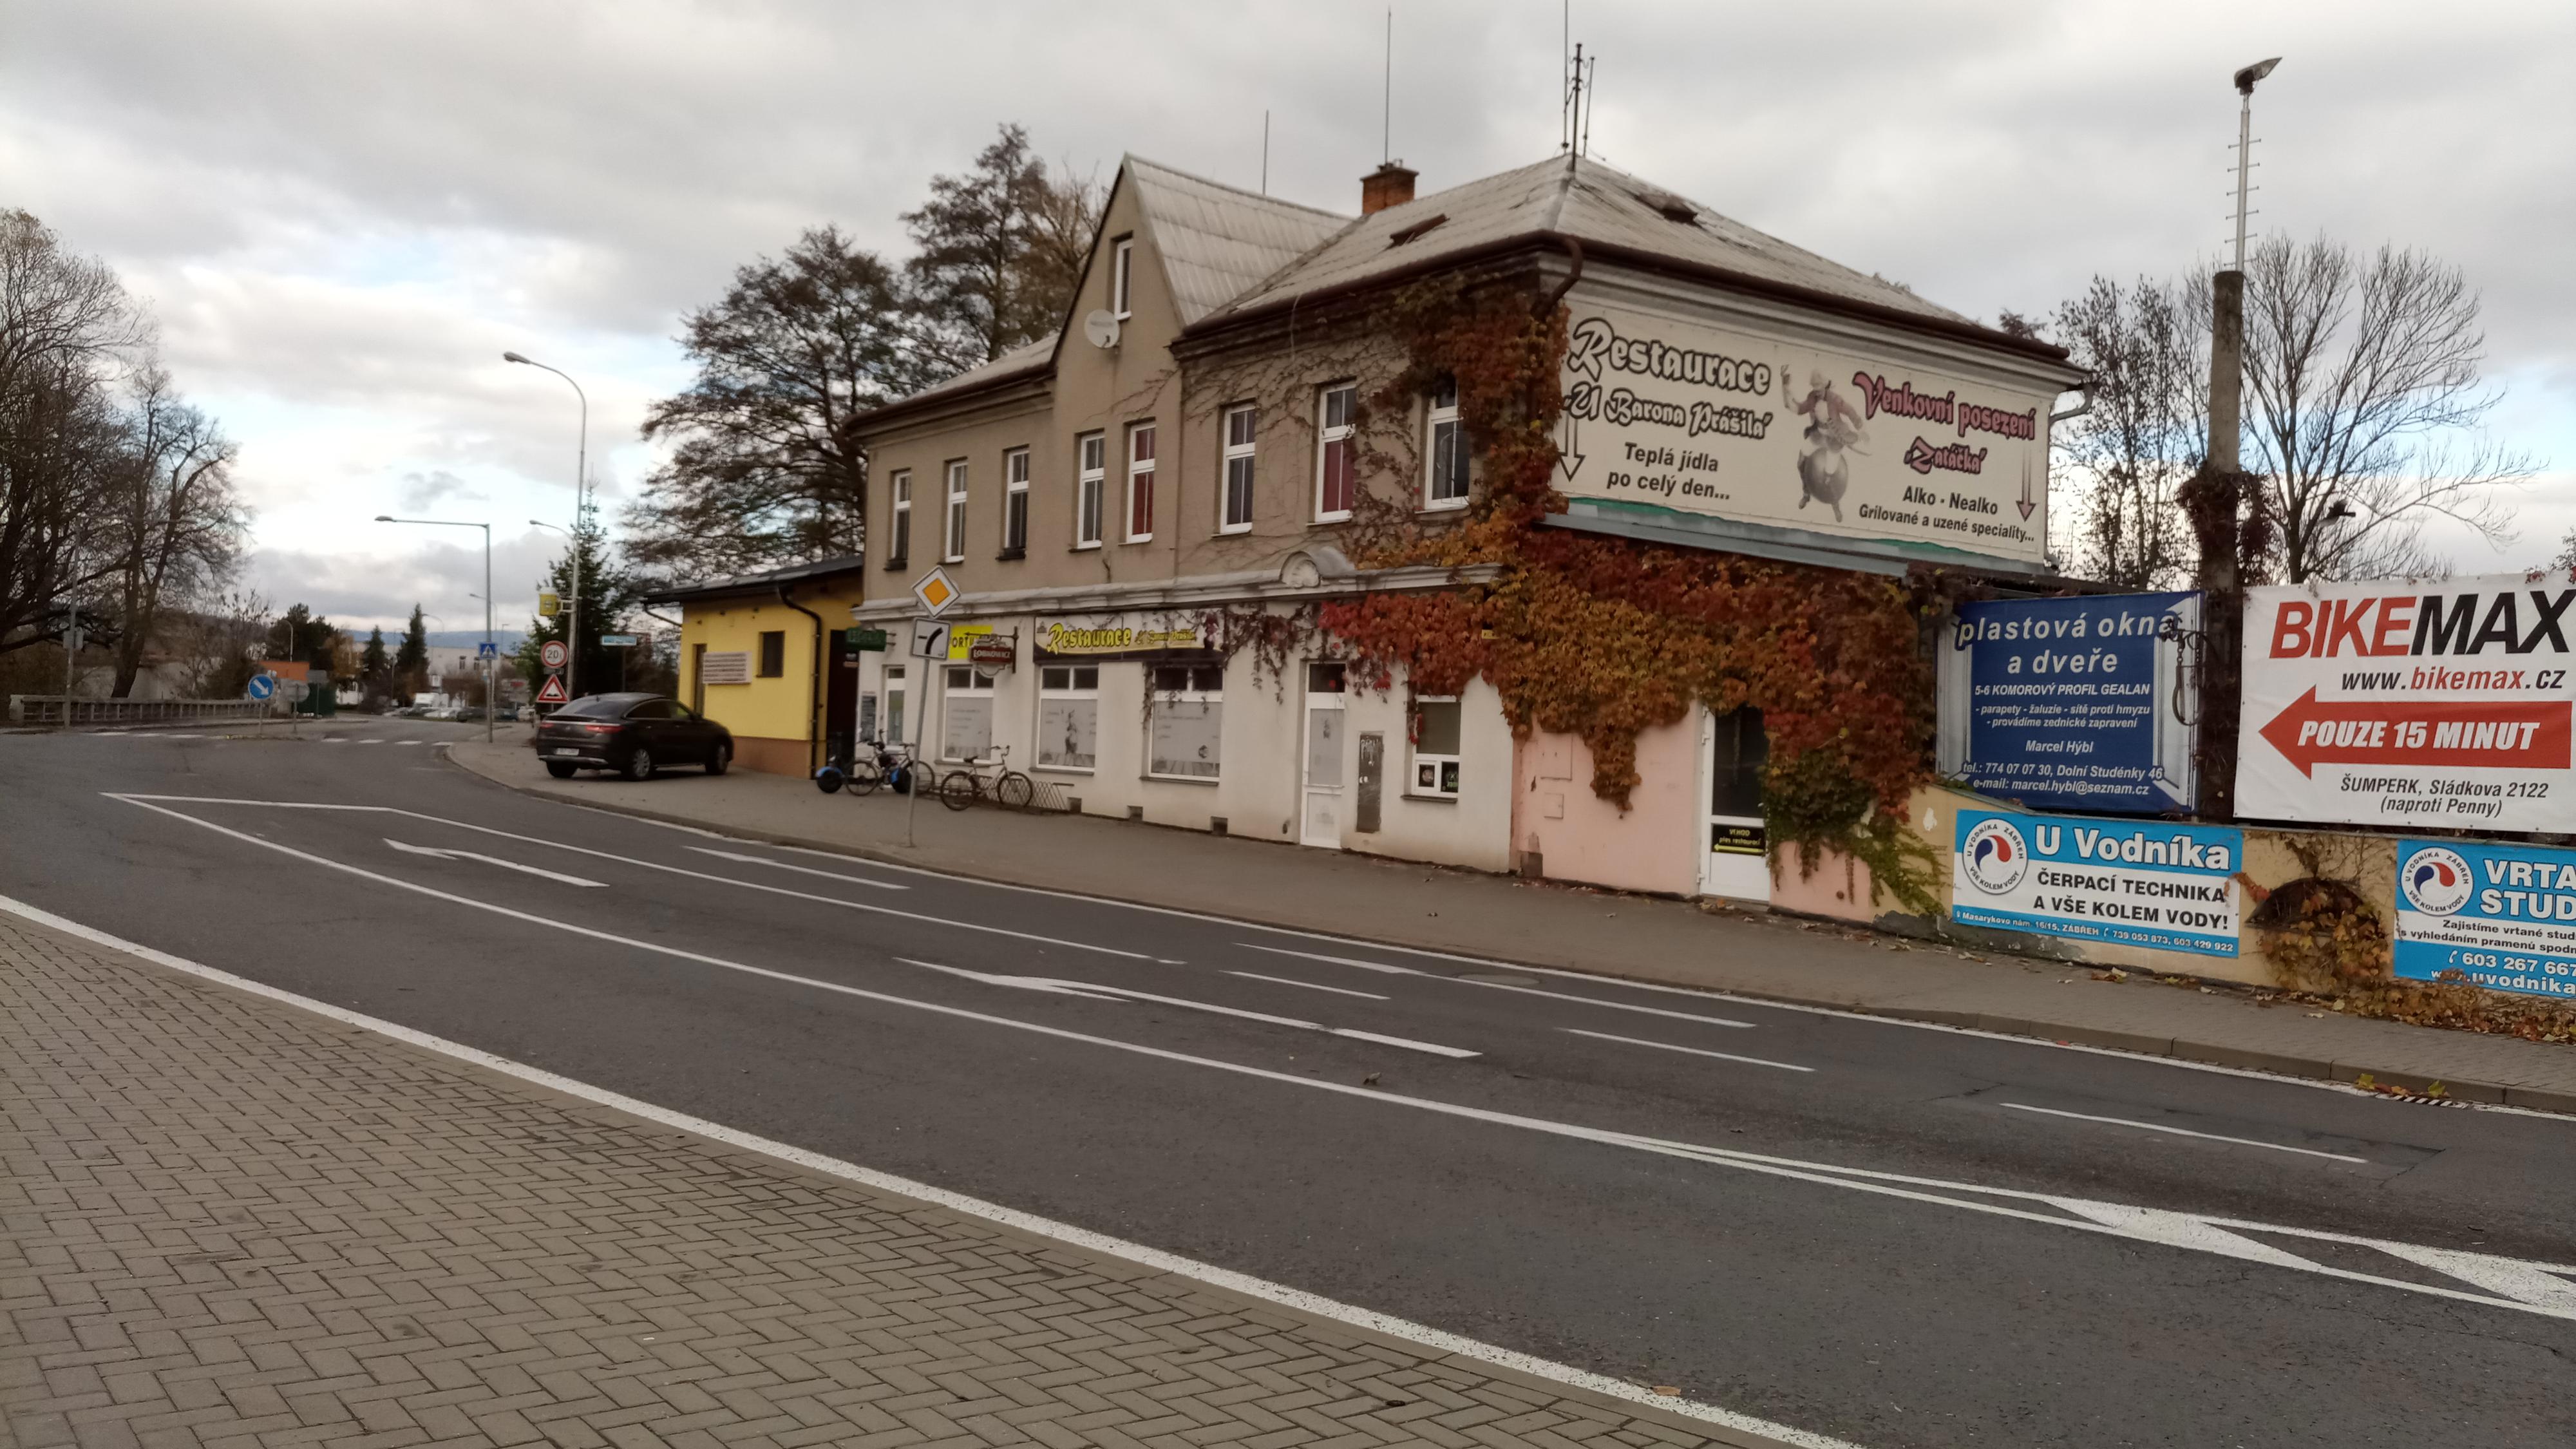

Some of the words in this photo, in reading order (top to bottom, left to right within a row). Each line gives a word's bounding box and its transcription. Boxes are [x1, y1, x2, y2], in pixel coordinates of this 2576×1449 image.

[1567, 317, 1771, 395] Restaurace
[1604, 388, 1686, 427] Barona
[1852, 371, 1955, 424] Venkovní
[1958, 402, 2036, 440] posezení
[1624, 441, 1674, 467] Teplá
[1678, 450, 1719, 472] jídla
[1606, 471, 1631, 489] po
[1637, 474, 1676, 497] celý
[1681, 478, 1730, 500] den...
[1902, 485, 1936, 506] Alko
[1949, 492, 1998, 515] Nealko
[1859, 504, 1918, 525] Grilované
[1922, 516, 1929, 526] a
[1933, 518, 1968, 532] uzené
[1971, 522, 2034, 543] speciality...
[1046, 622, 1132, 655] Restaurace
[1958, 612, 2088, 647] plastová
[2098, 611, 2175, 638] okna
[2269, 589, 2576, 658] BIKEMAX
[2007, 654, 2022, 674] a
[2032, 647, 2117, 674] dveře
[1975, 685, 1989, 696] 5-6
[1992, 683, 2056, 696] KOMOROVÝ
[2058, 684, 2098, 696] PROFIL
[2101, 684, 2150, 696] GEALAN
[2342, 666, 2566, 690] www.bikemax.cz
[1981, 705, 2021, 715] parapety
[2029, 704, 2061, 714] žaluzie
[2090, 704, 2114, 716] proti
[2116, 704, 2150, 716] hmyzu
[1992, 717, 2041, 728] provádíme
[2043, 717, 2086, 727] zednické
[2088, 717, 2138, 729] zapravení
[2025, 740, 2063, 752] Marcel
[2066, 741, 2094, 755] Hýbl
[2297, 720, 2387, 747] POUZE
[2393, 721, 2427, 748] 15
[2433, 721, 2540, 750] MINUT
[1963, 762, 1982, 773] tel.:
[1985, 762, 2003, 773] 774
[2006, 763, 2019, 773] 07
[2022, 764, 2035, 774] 07
[2038, 764, 2053, 777] 30,
[2057, 764, 2088, 777] Dolní
[2090, 765, 2146, 782] Studénky
[2148, 767, 2163, 779] 46
[1973, 778, 2009, 789] e-mail:
[2011, 779, 2149, 795] marcel.hybl@seznam.cz
[2341, 773, 2422, 795] ŠUMPERK,
[2429, 779, 2502, 797] Sládkova
[2506, 782, 2548, 798] 2122
[2381, 795, 2442, 814] (naproti
[2446, 799, 2503, 818] Penny)
[1968, 824, 1998, 848] VODNÍKA
[2004, 826, 2024, 859] ZÁBŘEH
[2035, 824, 2061, 855] U
[2073, 827, 2231, 871] Vodníka
[1970, 866, 1980, 881] VŠE
[1979, 878, 2003, 889] KOLEM
[2003, 871, 2019, 887] VODY
[2407, 852, 2439, 873] VODNÍKA
[2446, 855, 2469, 884] ZÁBŘEH
[2483, 858, 2576, 891] VRTA
[2037, 867, 2117, 892] ČERPACÍ
[2122, 879, 2225, 903] TECHNIKA
[2033, 895, 2045, 909] A
[2051, 895, 2086, 914] VŠE
[2093, 902, 2159, 922] KOLEM
[2166, 909, 2228, 929] VODY!
[2409, 890, 2421, 904] VŠE
[2420, 902, 2447, 912] KOLEM
[2447, 895, 2464, 909] VODY
[2480, 889, 2576, 921] STUD
[1962, 912, 2010, 925] Masarykovo
[2062, 923, 2099, 936] ZÁBŘEH
[2132, 933, 2148, 942] 053
[2193, 940, 2211, 949] 429
[2214, 942, 2233, 952] 922
[2410, 931, 2477, 944] vyhledáním
[2443, 920, 2499, 933] Zajistíme
[2503, 927, 2543, 938] vrtané
[2547, 931, 2576, 940] stud
[2462, 952, 2497, 968] 603
[2503, 956, 2538, 972] 267
[2544, 961, 2576, 977] 667
[2431, 970, 2576, 995] w.uvodnika
